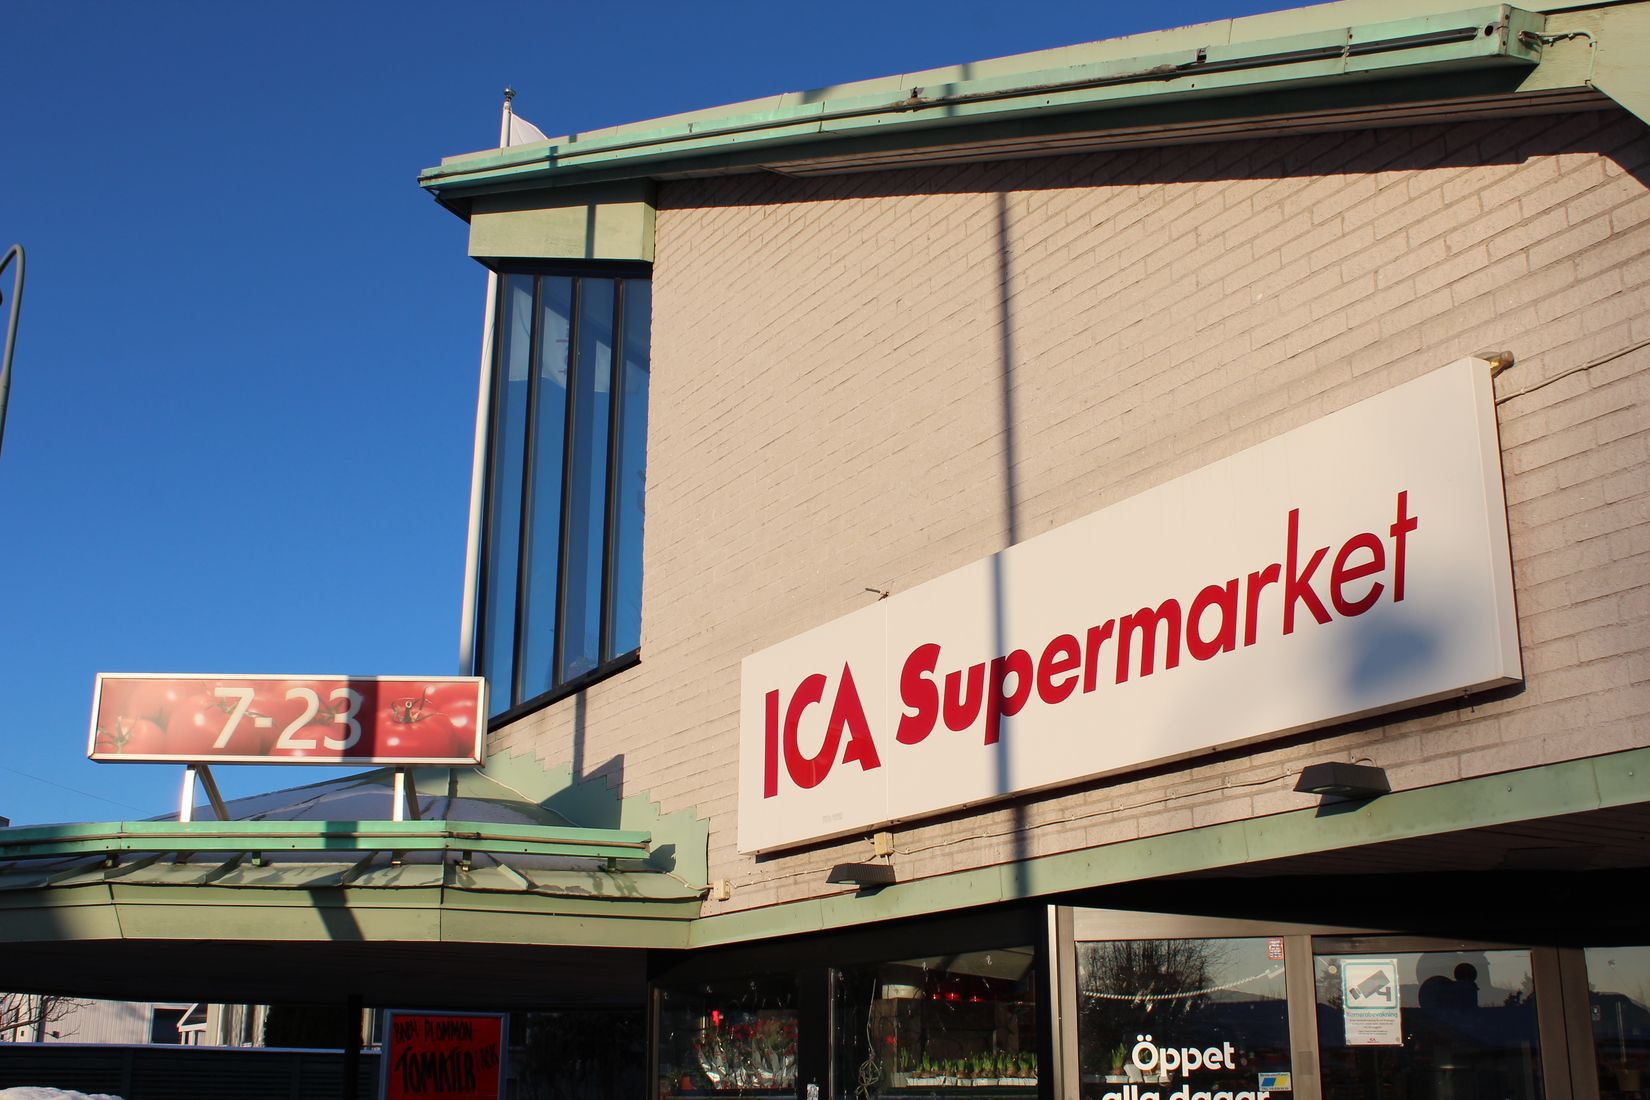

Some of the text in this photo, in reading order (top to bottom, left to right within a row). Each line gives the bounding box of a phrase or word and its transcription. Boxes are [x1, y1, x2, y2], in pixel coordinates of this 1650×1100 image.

[763, 490, 1418, 799] ICA Supermarket
[212, 687, 363, 751] 7-23
[1131, 1034, 1236, 1077] Öppet
